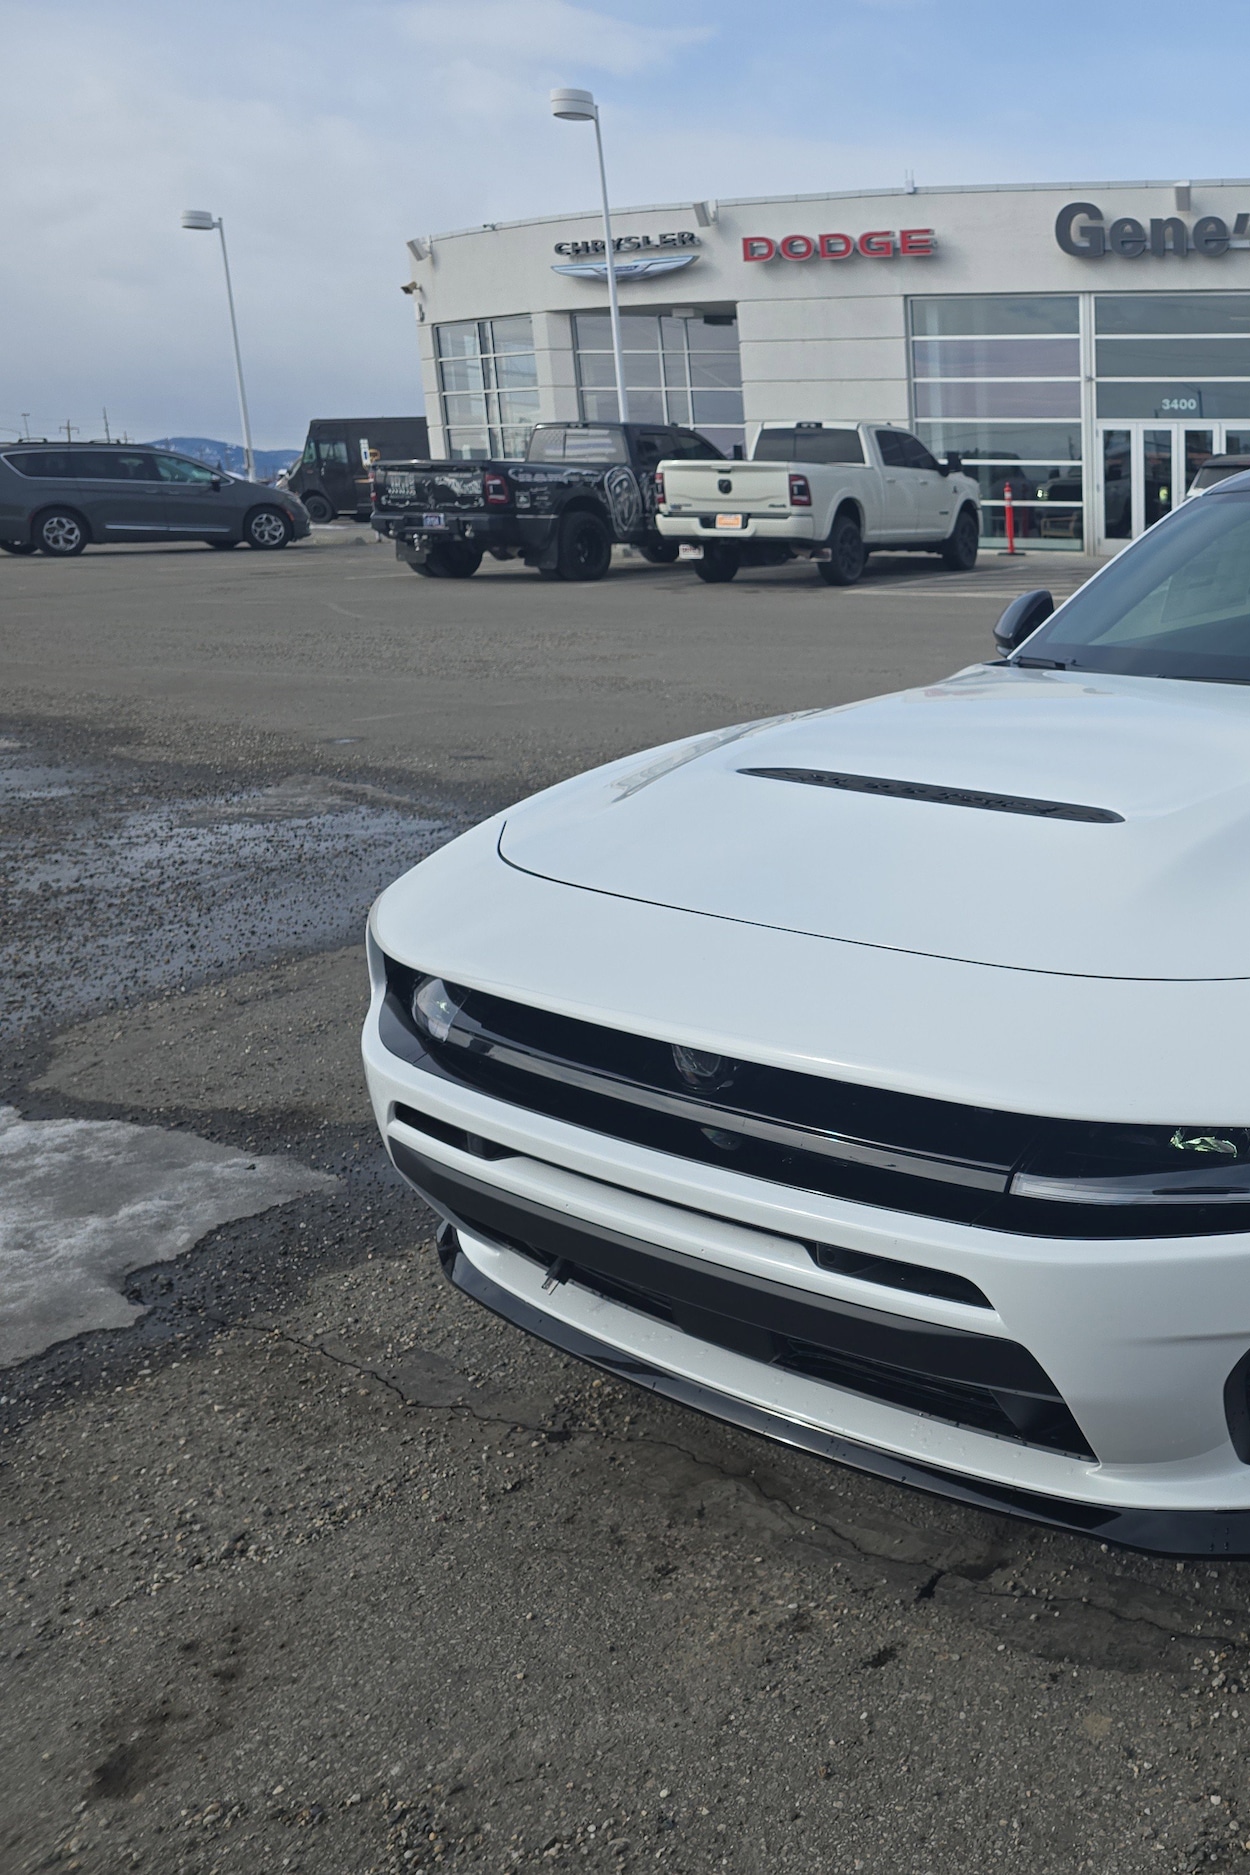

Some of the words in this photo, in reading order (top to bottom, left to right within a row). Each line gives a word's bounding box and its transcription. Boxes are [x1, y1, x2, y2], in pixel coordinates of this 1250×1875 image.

[554, 231, 700, 256] CHRYSLER
[742, 229, 935, 262] DODGE
[1161, 398, 1197, 410] 3400
